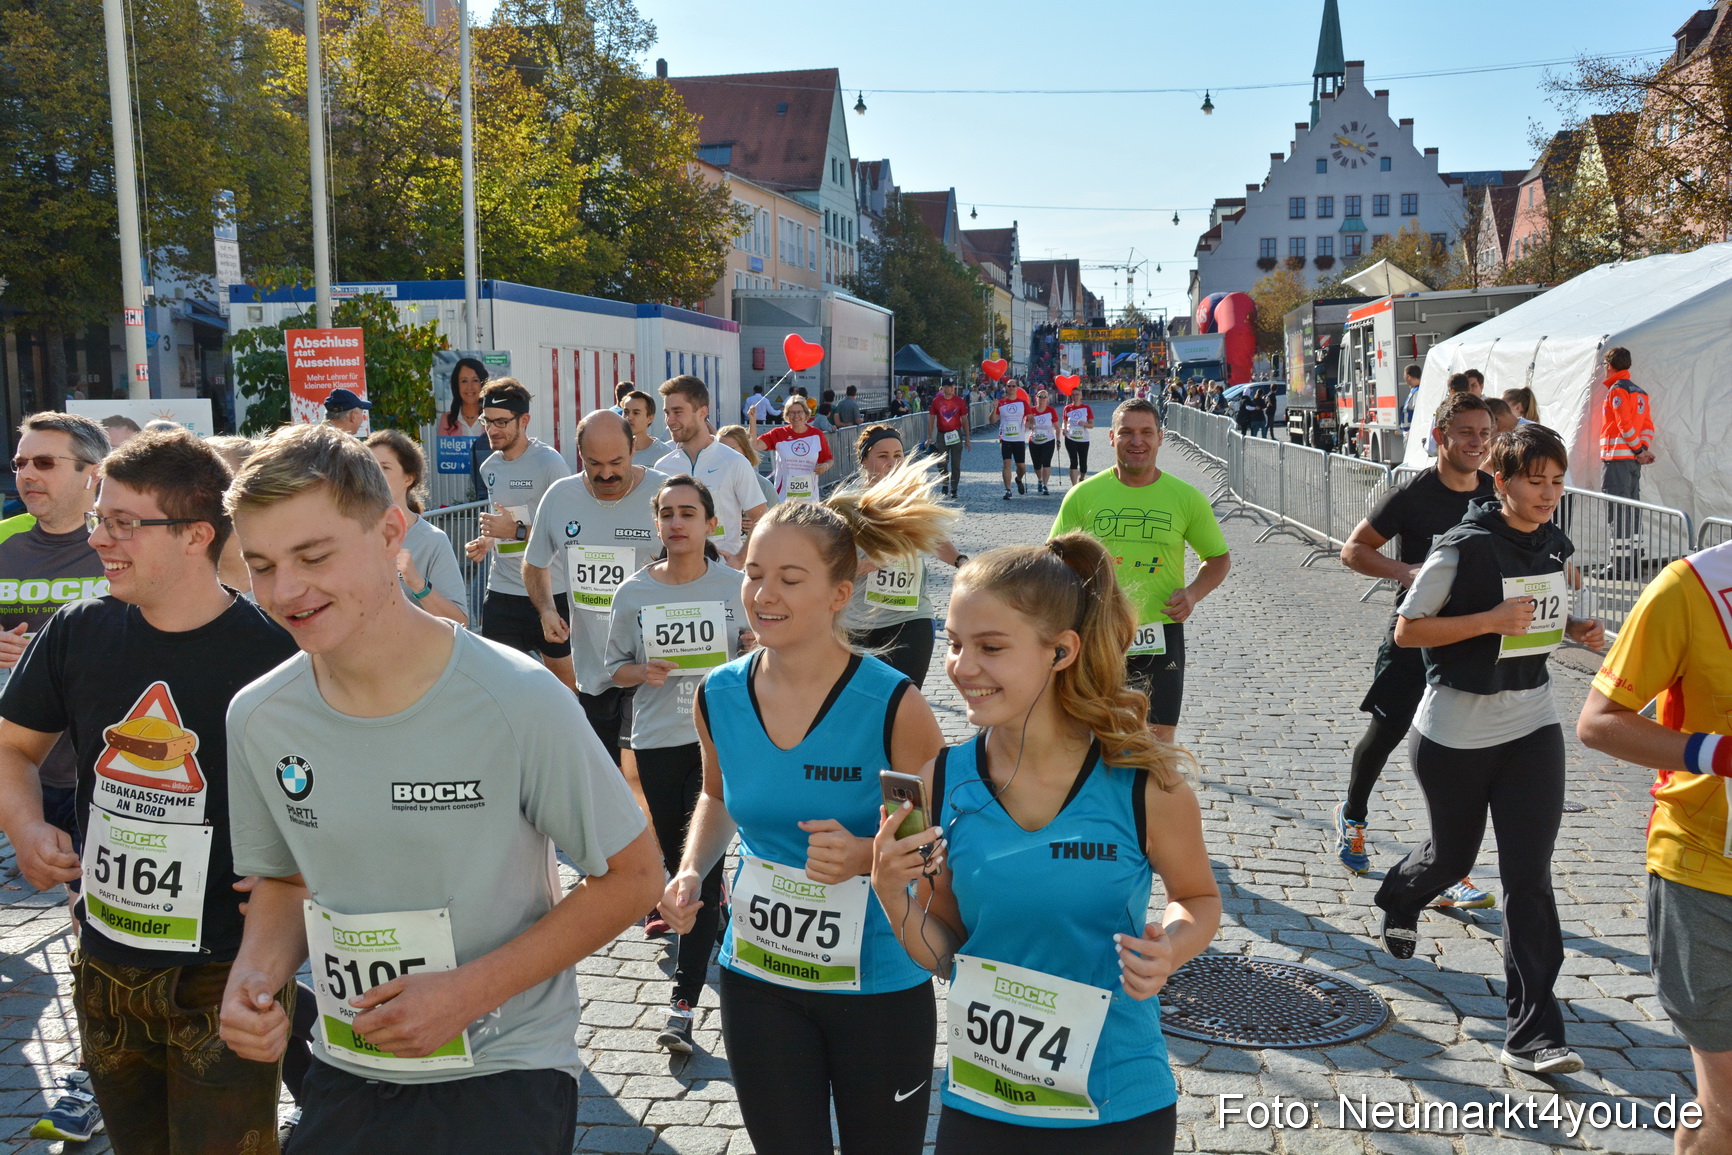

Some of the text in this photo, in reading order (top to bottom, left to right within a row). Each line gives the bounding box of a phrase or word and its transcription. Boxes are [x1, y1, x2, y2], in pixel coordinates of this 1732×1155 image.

[163, 335, 171, 352] 3
[294, 336, 359, 348] Abschluss
[1085, 330, 1112, 338] START
[294, 349, 315, 357] statt
[295, 356, 360, 368] Ausschluss!
[306, 372, 358, 382] Mehr Lehrer für
[333, 381, 359, 389] Klassen.
[440, 438, 466, 452] Helga
[790, 481, 808, 489] 5204
[615, 528, 651, 538] BOCK
[1093, 508, 1172, 539] OPF
[585, 551, 615, 559] BOCK
[577, 563, 624, 585] 5129
[876, 569, 915, 588] 5167
[0, 577, 111, 604] BOCK
[0, 605, 24, 614] spired
[27, 605, 39, 614] by
[666, 608, 701, 617] BOCK
[1528, 595, 1560, 622] 212
[655, 620, 714, 646] 5210
[804, 764, 862, 782] THULE
[101, 780, 195, 807] LEBAKAASSEMME
[391, 780, 484, 803] BOCK
[116, 799, 166, 817] AN BORD
[286, 804, 318, 820] PARTL
[391, 803, 418, 812] inspired
[419, 803, 427, 812] by
[452, 801, 486, 810] concepts
[289, 814, 319, 828] Neumarkt
[110, 826, 168, 848] BOCK
[1049, 842, 1118, 861] THULE
[94, 845, 183, 898] 5164
[772, 874, 826, 898] BOCK
[99, 889, 160, 911] PARTL Neumarkt
[101, 905, 171, 935] Alexander
[749, 894, 841, 949] 5075
[332, 926, 399, 947] BOCK
[756, 935, 819, 959] PARTL Neumarkt
[763, 953, 820, 980] Hannah
[994, 976, 1058, 1009] BOCK
[992, 993, 1010, 1003] inspired
[1032, 1005, 1056, 1015] concepts
[966, 1000, 1071, 1072] 5074
[974, 1051, 1041, 1083] PARTL Neumarkt
[994, 1078, 1036, 1102] Alina
